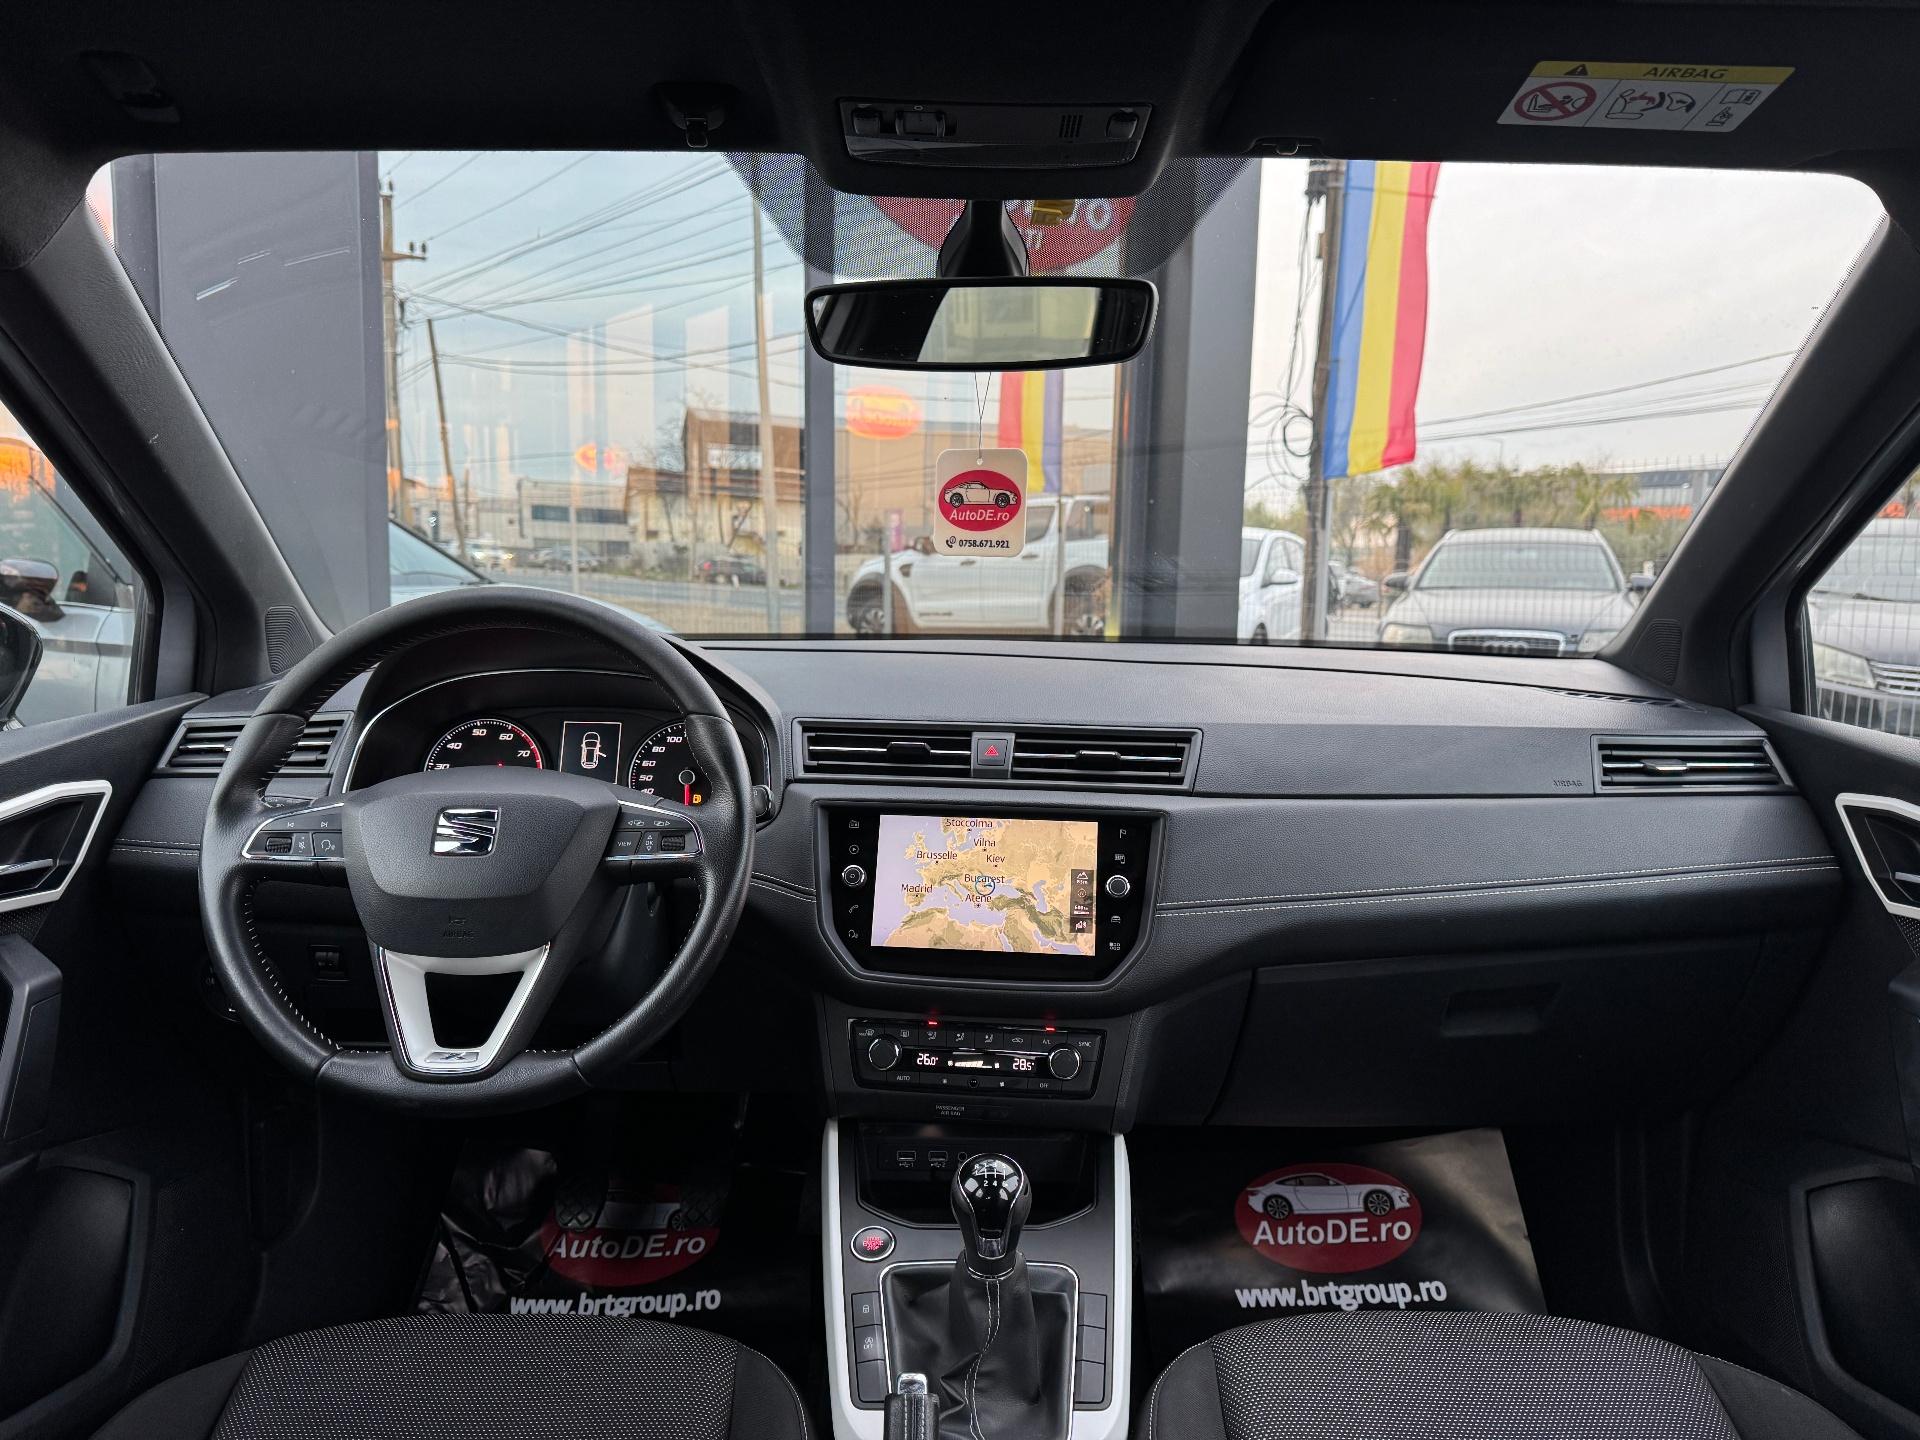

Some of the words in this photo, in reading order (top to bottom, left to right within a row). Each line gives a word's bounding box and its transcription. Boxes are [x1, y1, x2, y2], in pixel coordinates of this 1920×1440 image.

[1642, 67, 1728, 79] AIRBAG
[949, 509, 1010, 521] AutoDE.ro
[958, 539, 1010, 548] 0758.671.921
[472, 728, 487, 736] 50
[498, 733, 514, 741] 60
[446, 742, 463, 750] 40
[638, 774, 654, 782] 50
[946, 818, 993, 828] Stoccolma
[973, 838, 996, 847] Vilna
[916, 850, 958, 860] Brusselle
[986, 854, 1006, 863] Kiev
[964, 874, 1006, 884] Bucarest
[901, 884, 933, 893] Madrid
[965, 894, 992, 903] Atene
[983, 1179, 989, 1187] 2
[1252, 1218, 1412, 1246] AutoDE.ro
[549, 1233, 706, 1259] AutoDE.ro
[1234, 1279, 1447, 1311] www.brtgroup.ro
[510, 1288, 721, 1318] www.brtgroup.ro
